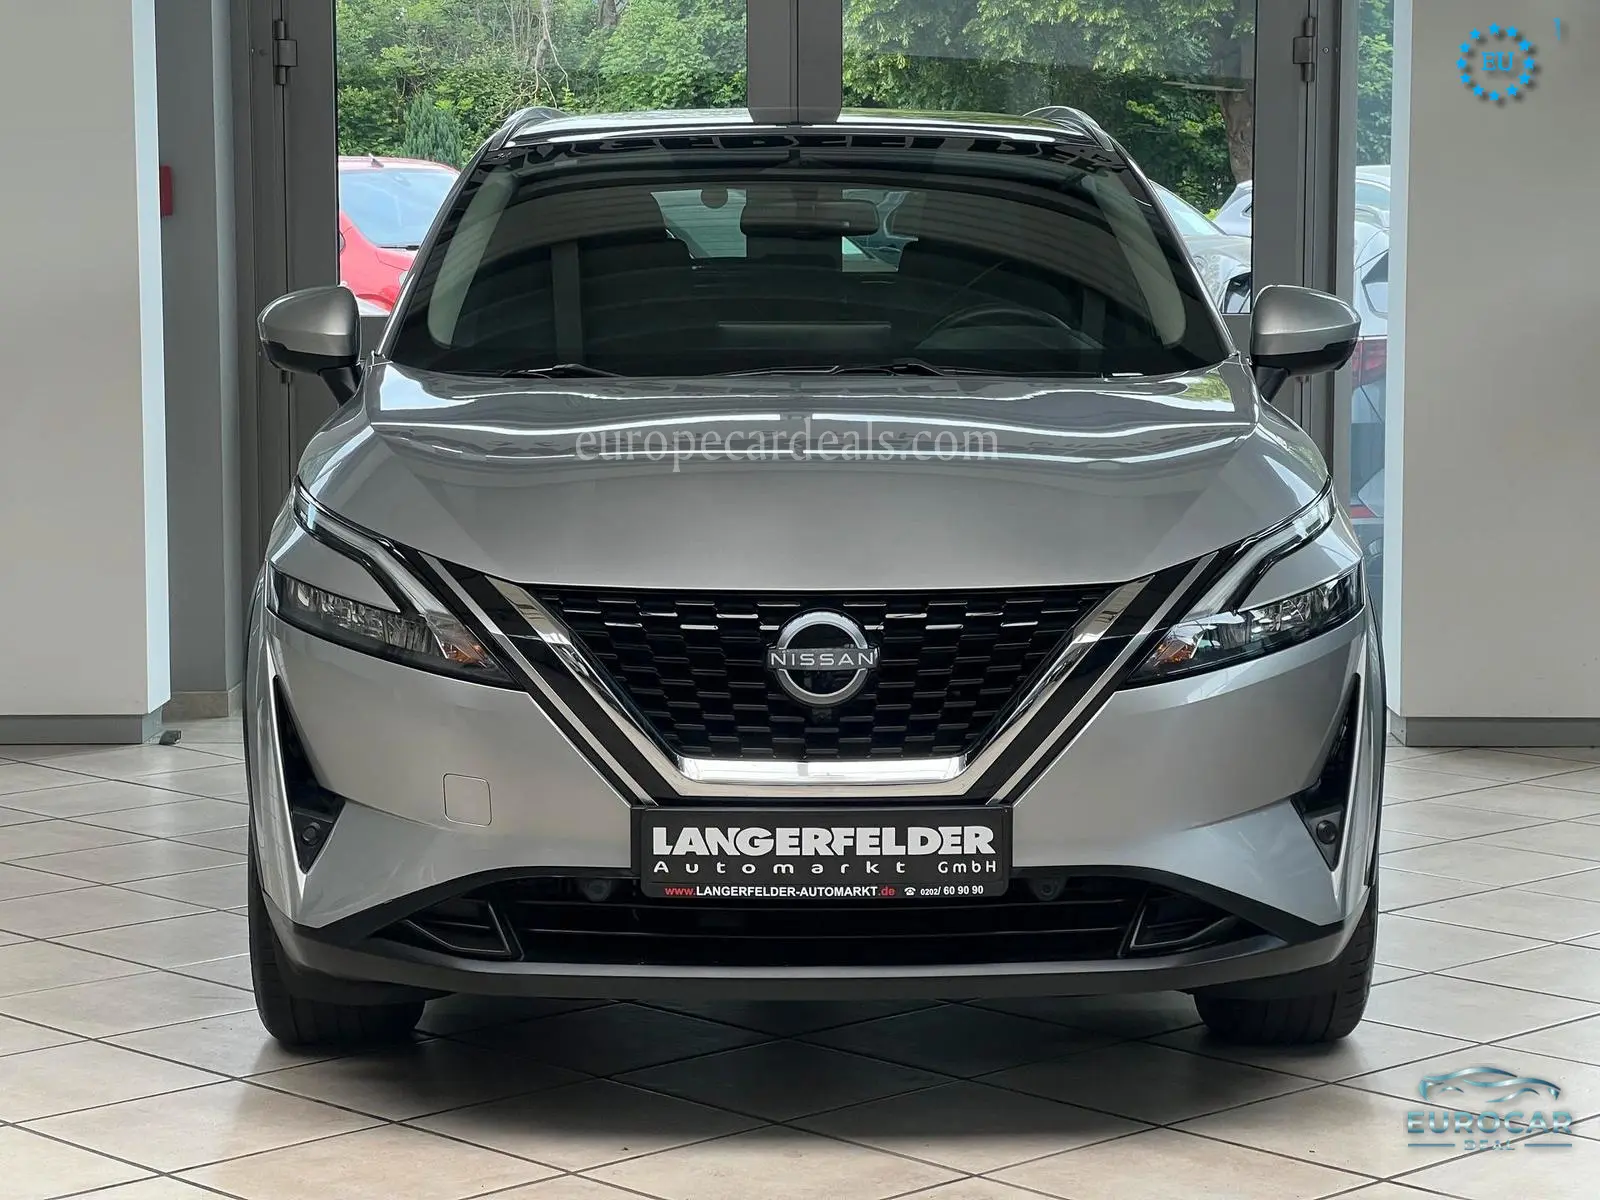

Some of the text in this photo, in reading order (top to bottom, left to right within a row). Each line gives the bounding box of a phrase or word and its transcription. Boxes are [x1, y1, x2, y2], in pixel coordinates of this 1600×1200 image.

[770, 652, 874, 666] NISSAN
[652, 826, 996, 856] LANGERFELDER
[653, 860, 997, 874] Automarkt GmbH
[664, 884, 984, 897] www.LANGERFELDER-AUTOMARKT.de 0202/ 60 90 90
